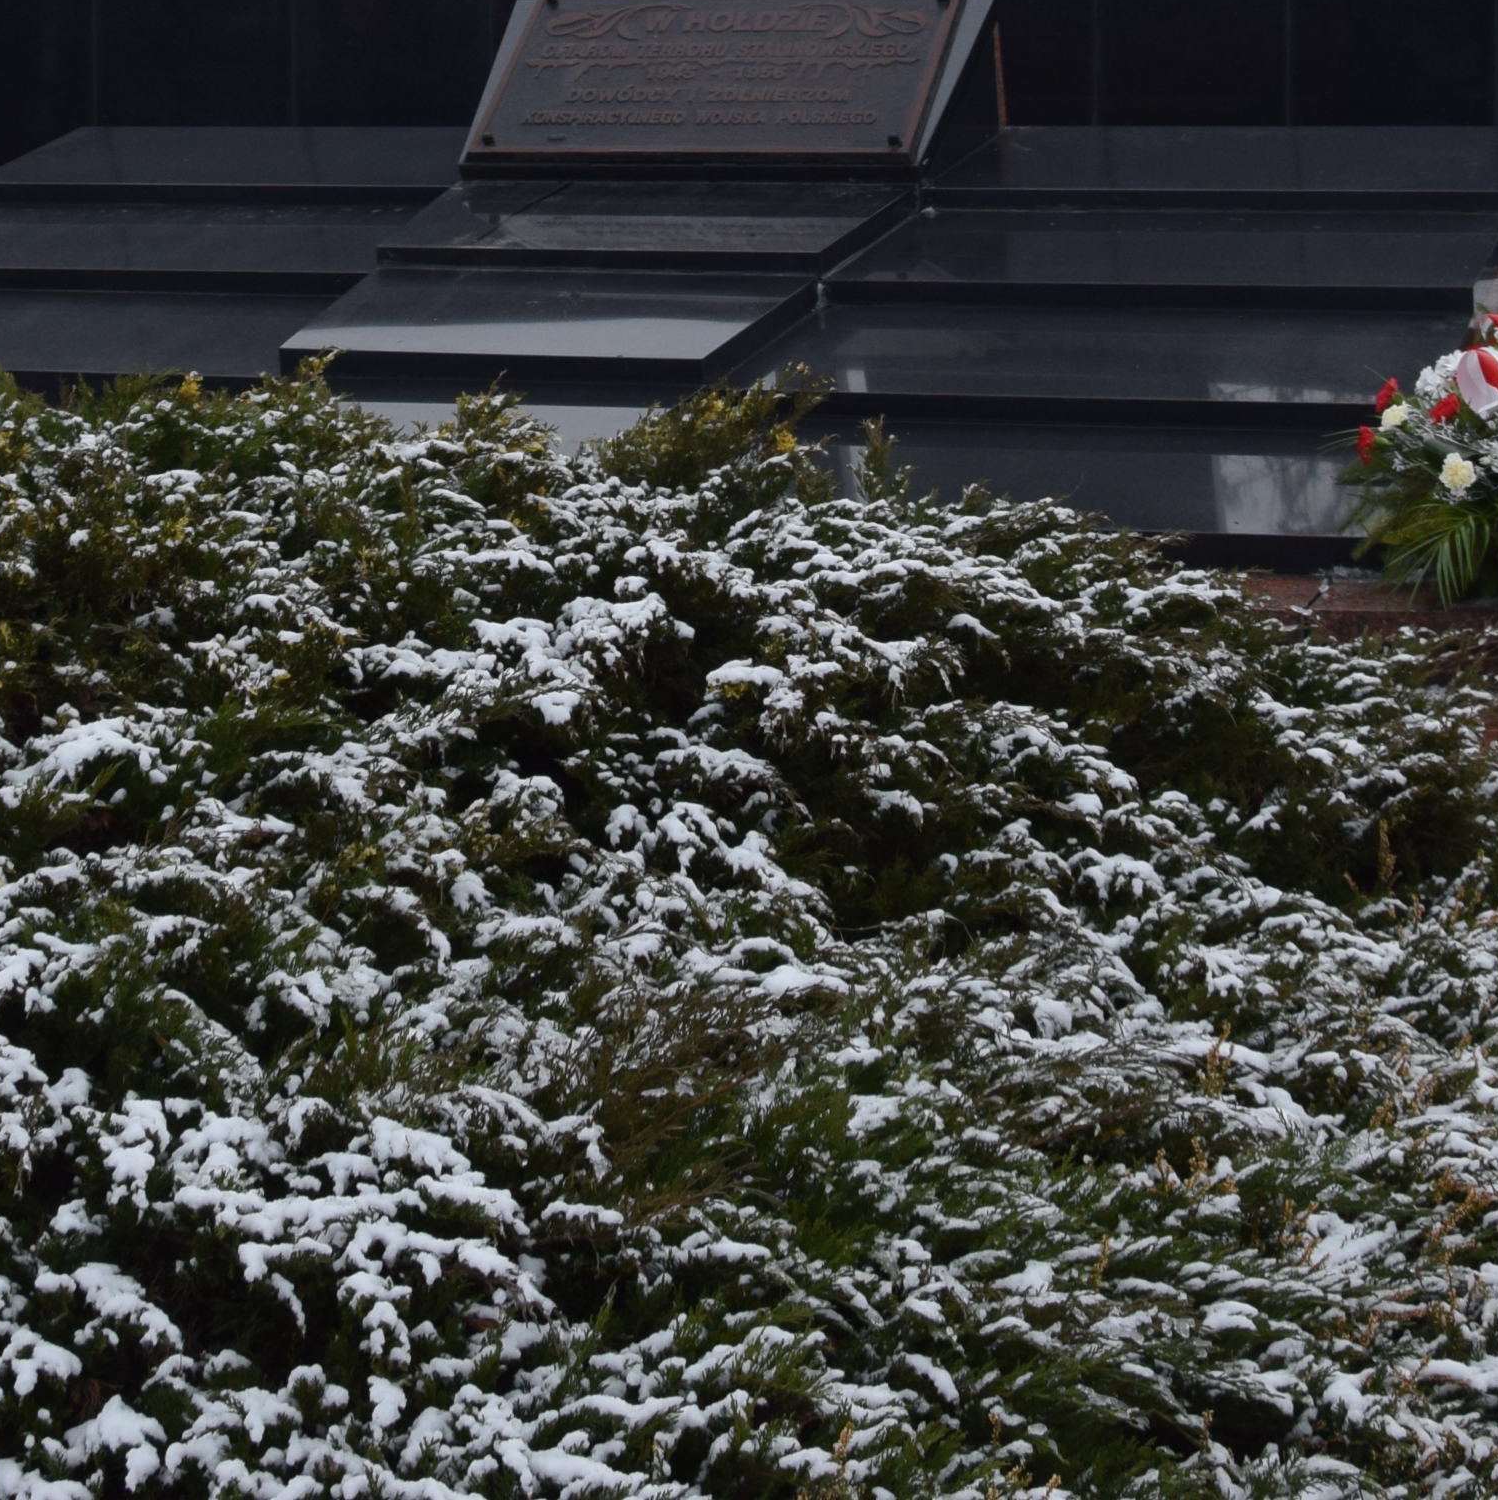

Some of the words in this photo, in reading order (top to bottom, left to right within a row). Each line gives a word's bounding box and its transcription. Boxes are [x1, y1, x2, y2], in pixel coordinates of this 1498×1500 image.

[645, 12, 678, 33] W
[682, 10, 831, 33] HOŁDZIE
[541, 42, 627, 59] OFIAROM
[638, 42, 729, 58] TERRORU
[737, 41, 911, 58] STALINOWSKIEGO
[645, 66, 697, 80] 1945
[735, 65, 788, 79] 1956
[566, 85, 678, 103] DOWÓDCY
[521, 110, 686, 125] KONSPIRACYJNEGO
[696, 110, 766, 125] WOJSKA
[775, 110, 877, 125] POLSKIEGO
